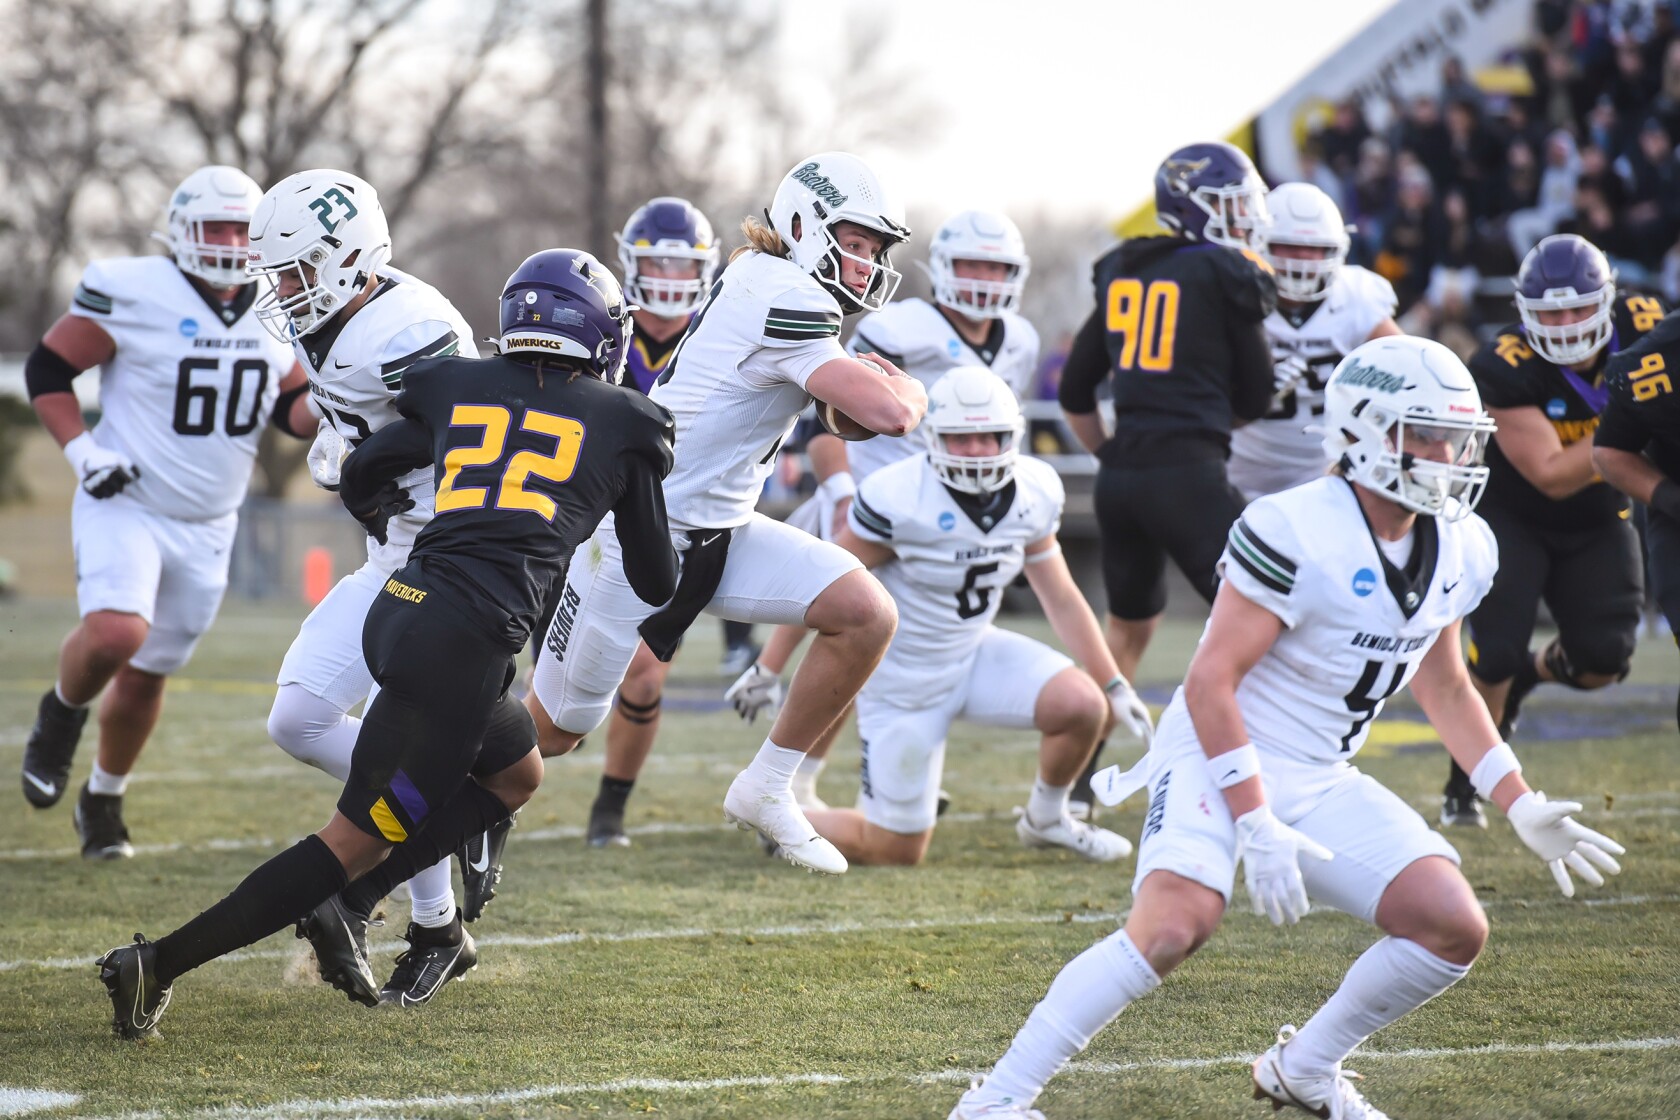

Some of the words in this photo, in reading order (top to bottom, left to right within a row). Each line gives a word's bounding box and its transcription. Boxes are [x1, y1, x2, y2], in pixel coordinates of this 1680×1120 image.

[308, 187, 358, 235] 23
[506, 338, 562, 350] MAVERICKS
[532, 313, 541, 322] 22
[1106, 278, 1180, 371] 90
[172, 357, 269, 437] 60
[1627, 352, 1673, 402] 96
[435, 403, 586, 524] 22
[384, 578, 428, 604] MAVERICKS
[547, 582, 580, 662] BEAVERS
[1340, 659, 1409, 752] 4
